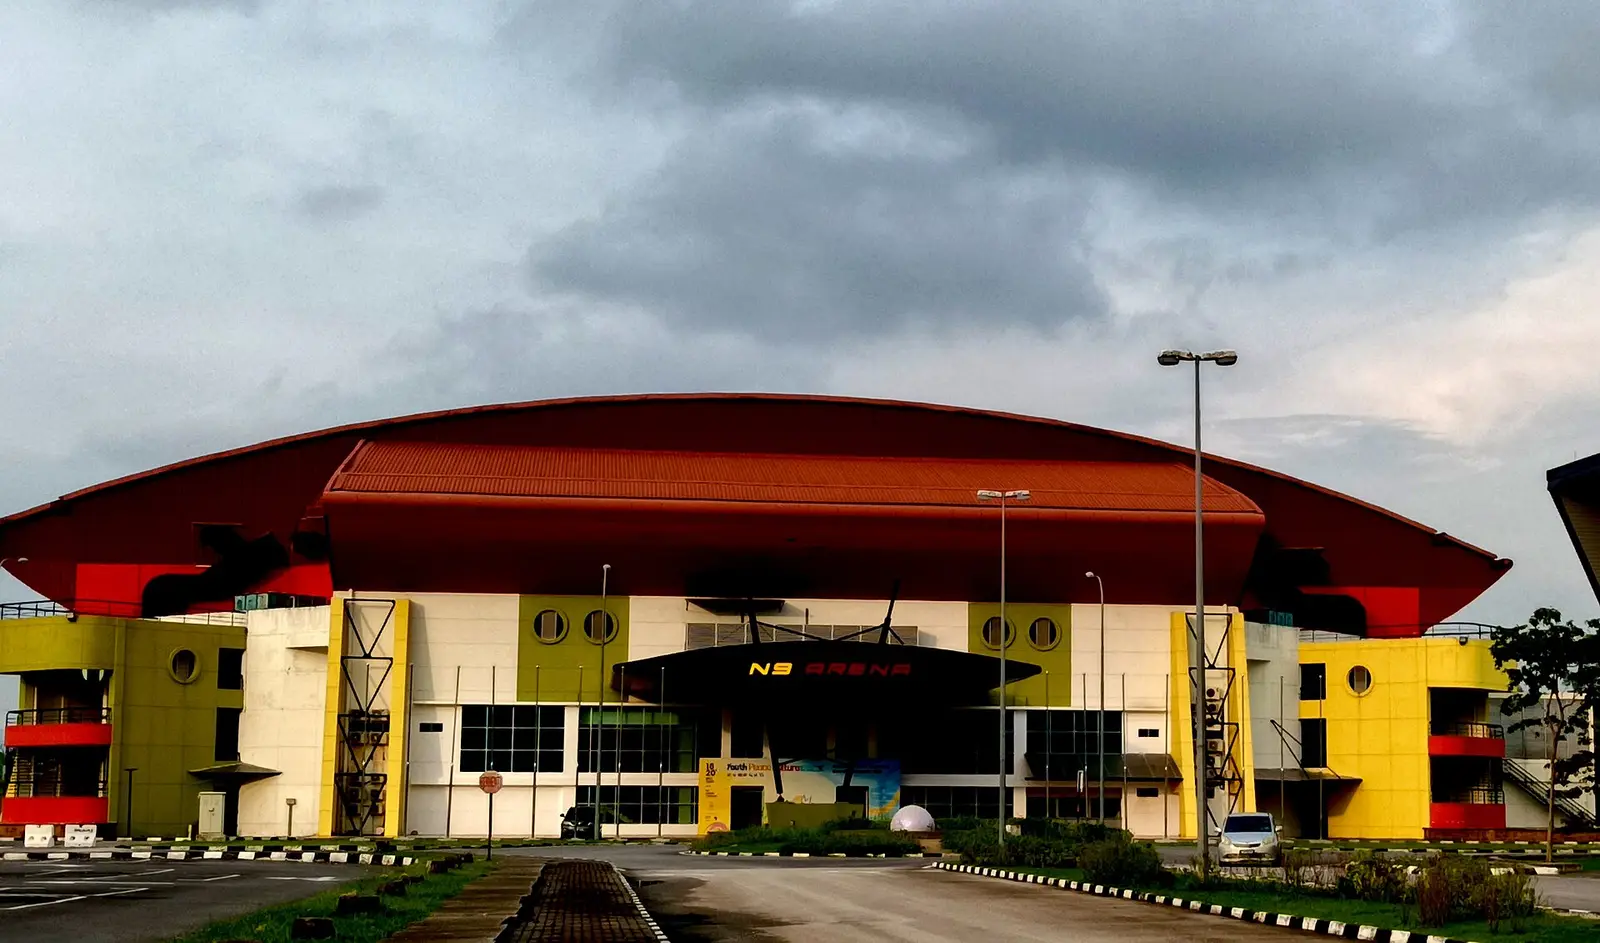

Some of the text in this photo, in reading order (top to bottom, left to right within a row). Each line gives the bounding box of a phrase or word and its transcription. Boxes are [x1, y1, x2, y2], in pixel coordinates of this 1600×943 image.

[749, 663, 910, 676] N9 ARENA
[727, 763, 747, 771] Youth
